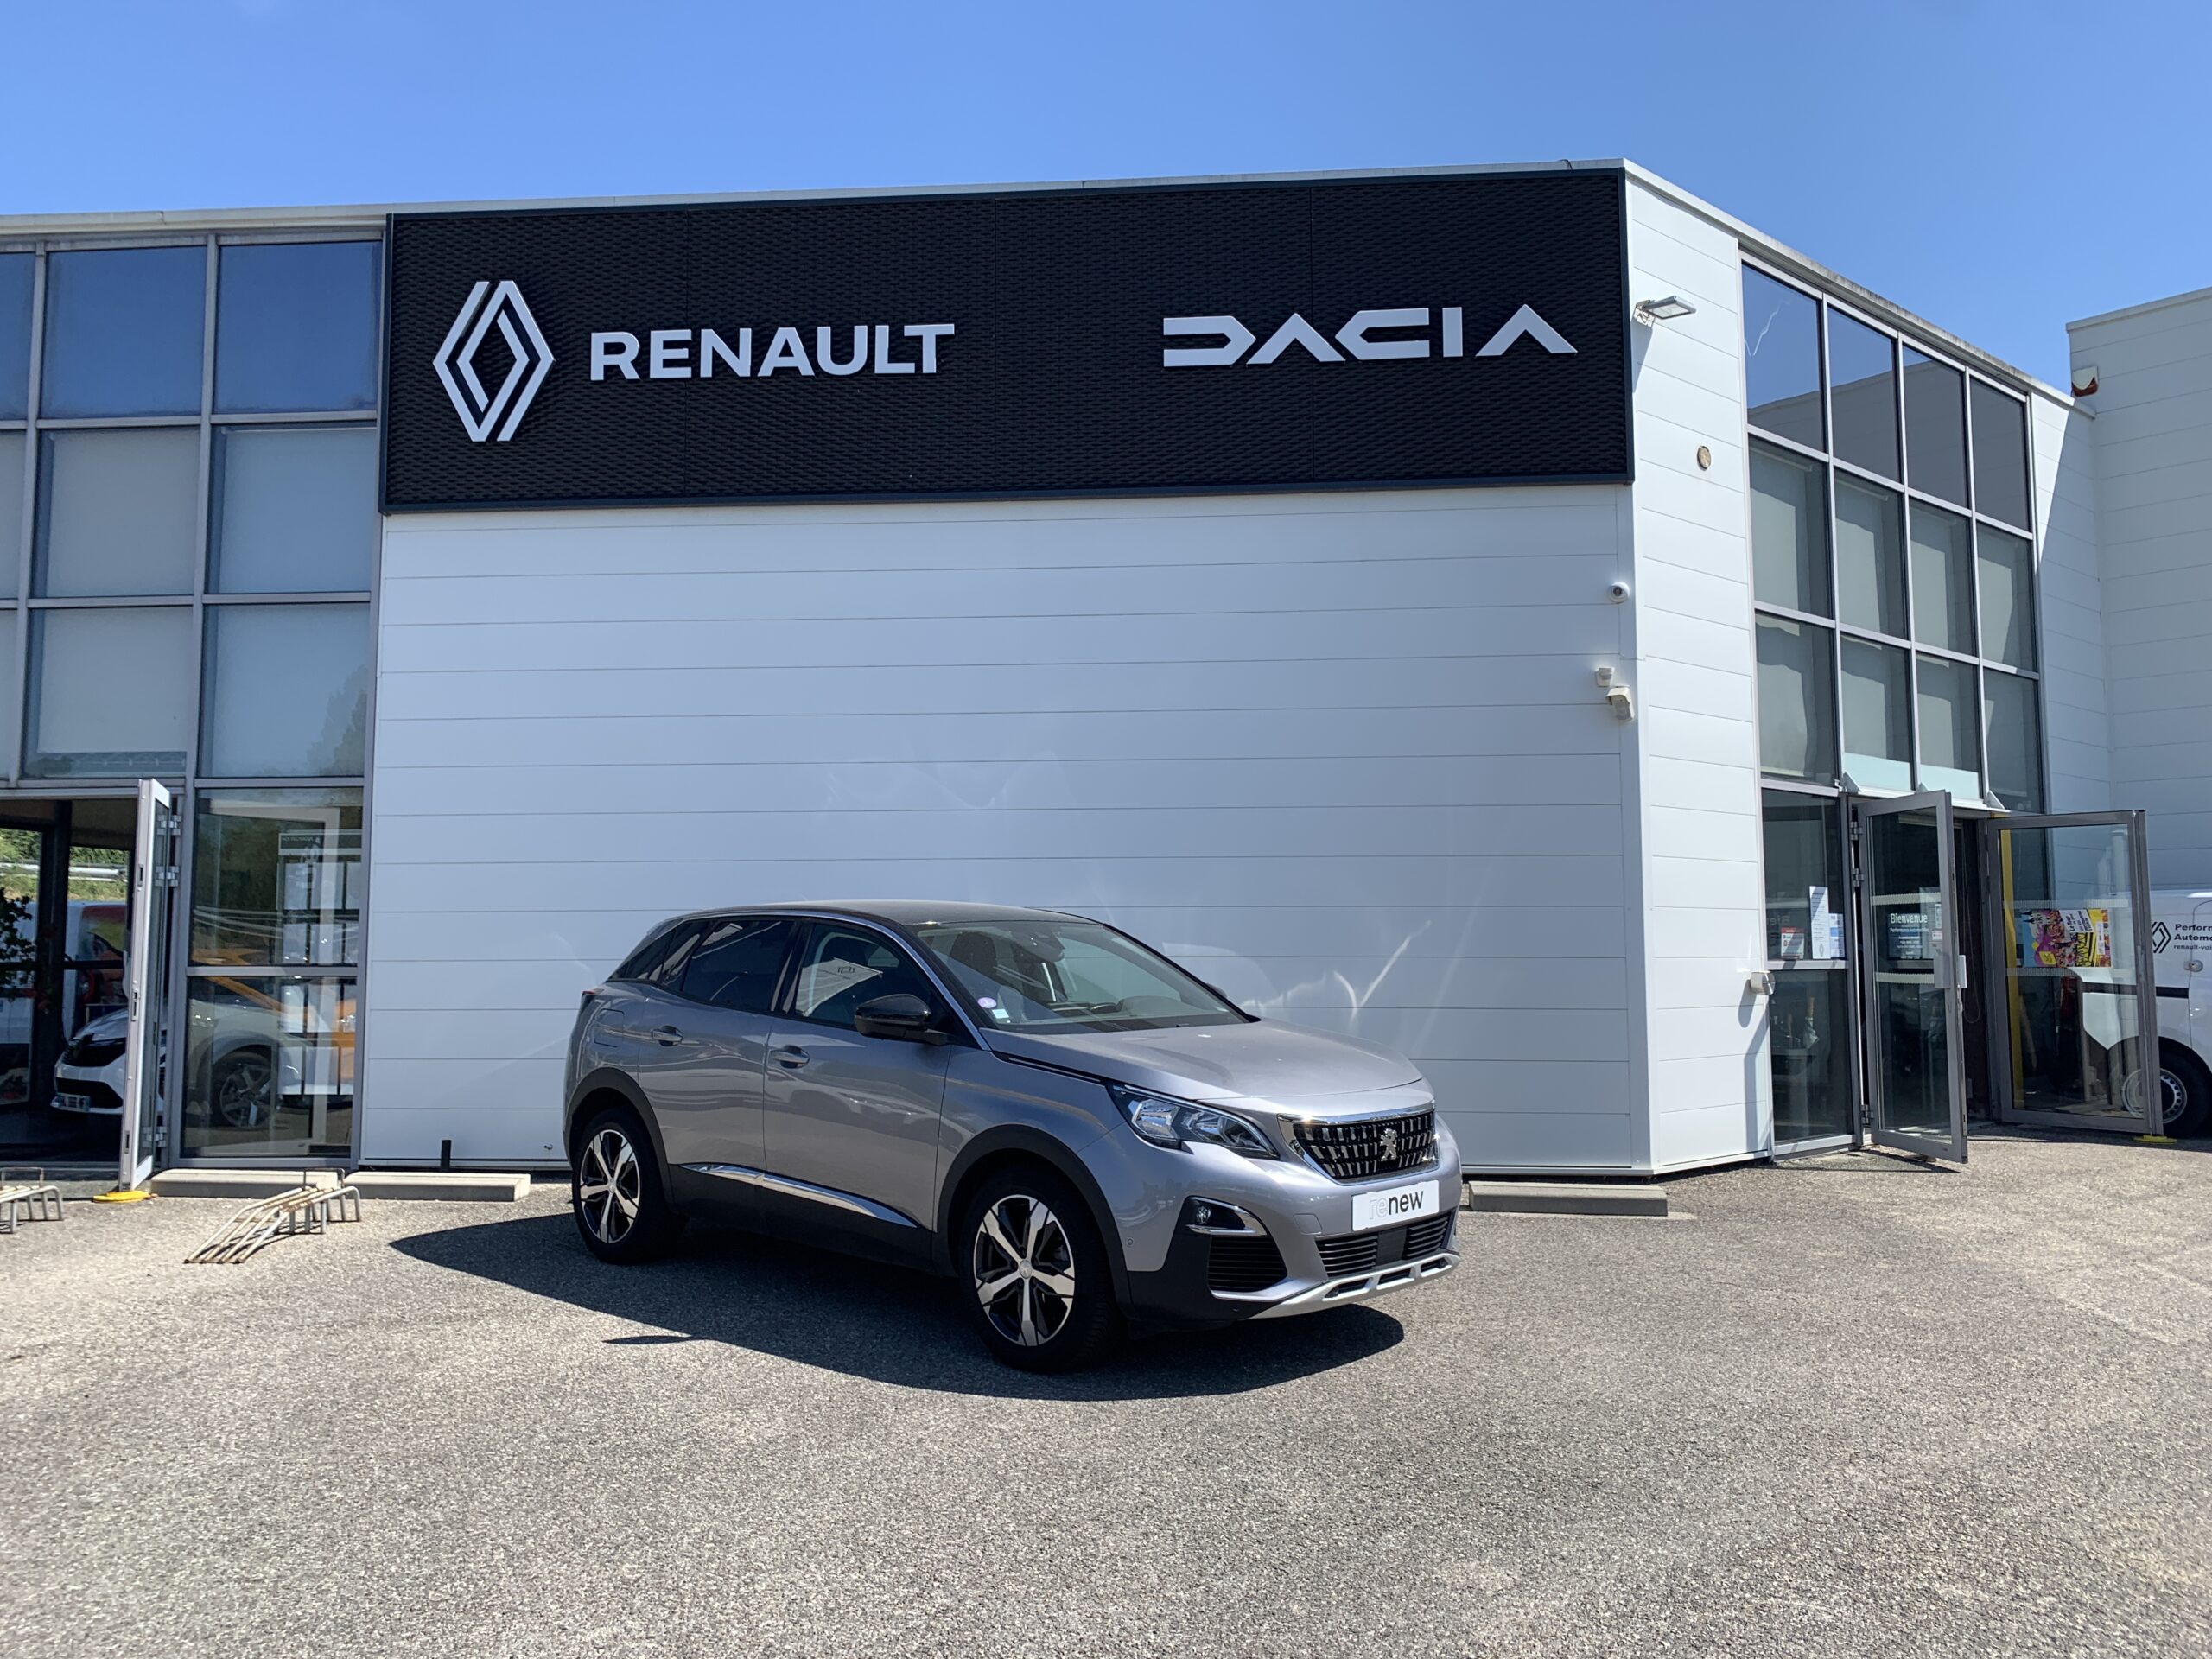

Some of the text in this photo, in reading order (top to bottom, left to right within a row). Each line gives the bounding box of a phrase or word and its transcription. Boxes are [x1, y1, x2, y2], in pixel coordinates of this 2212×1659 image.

[590, 323, 955, 381] RENAULT
[1163, 303, 1578, 367] DACIA
[1890, 912, 1928, 924] Bienvenue
[1369, 1191, 1423, 1220] renew
